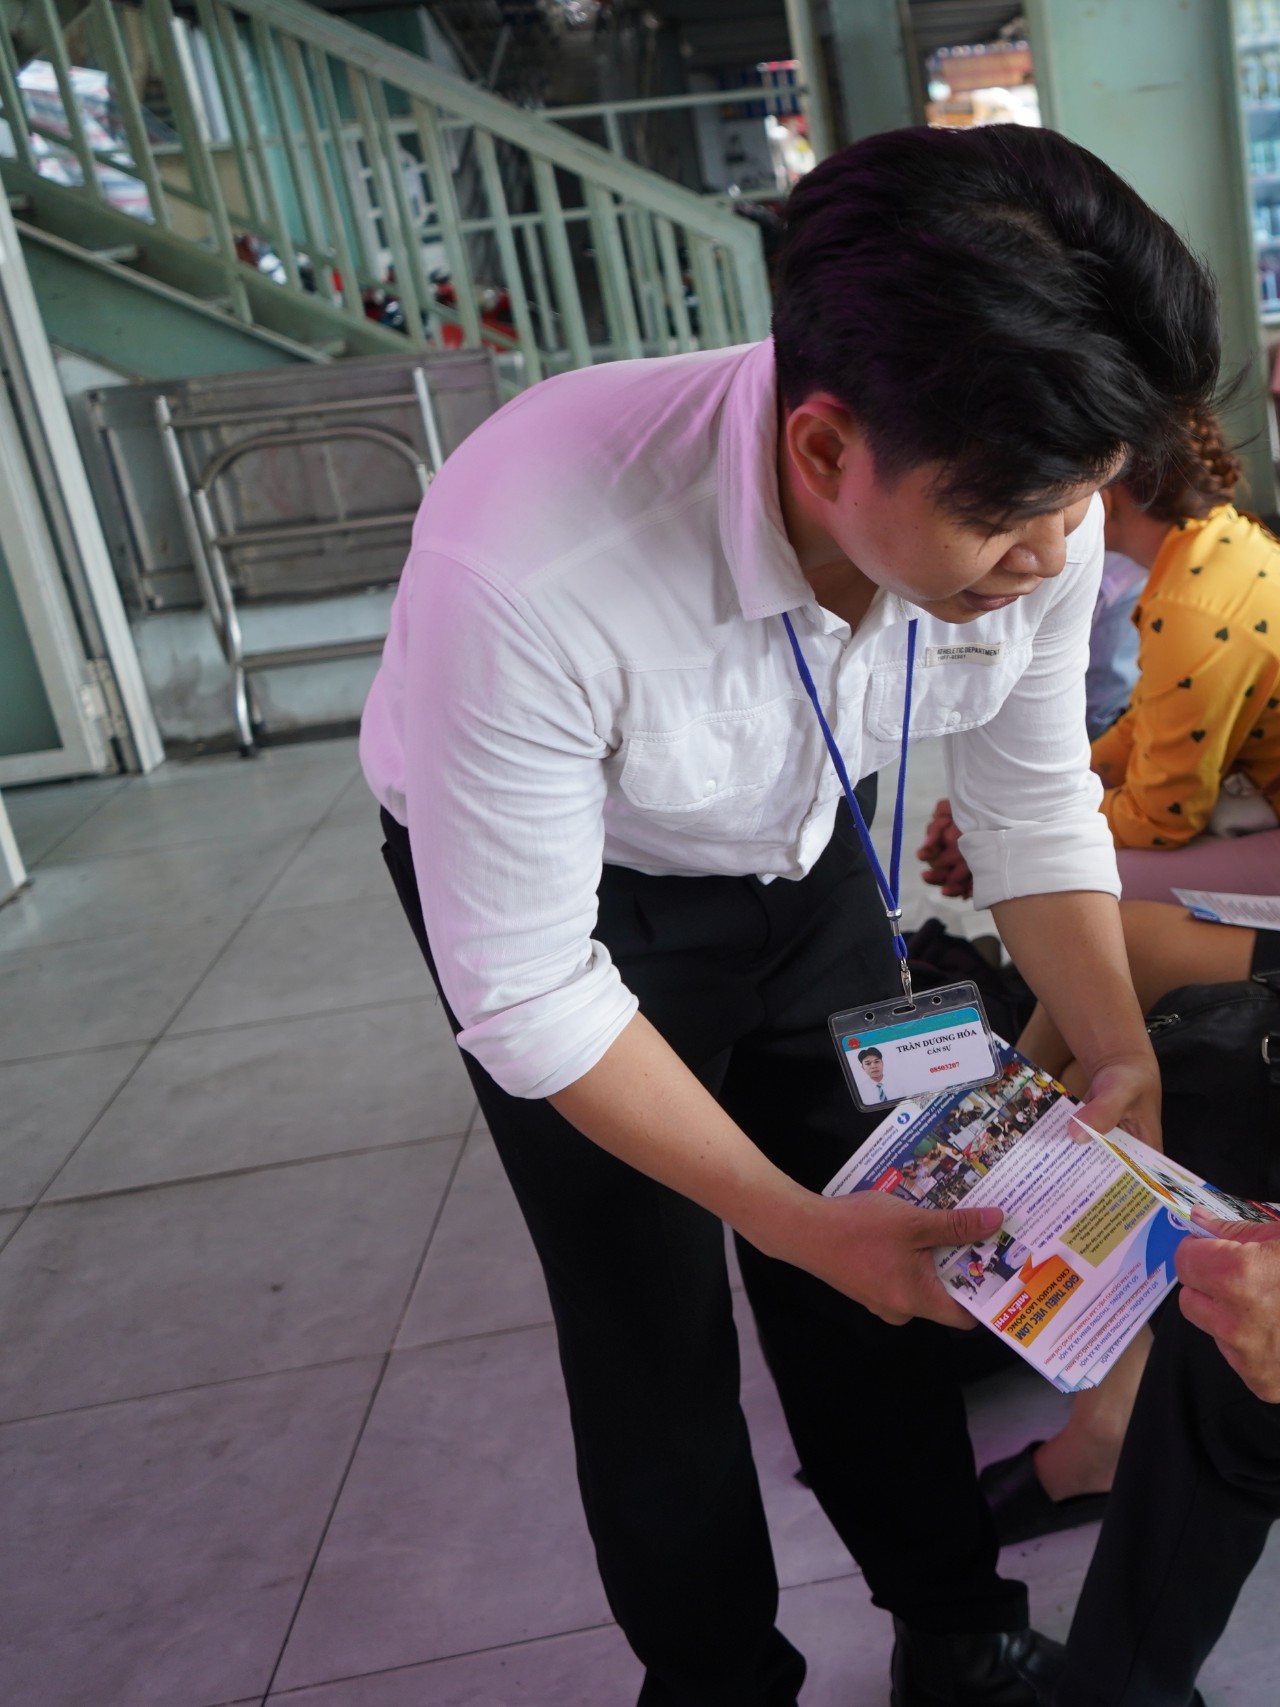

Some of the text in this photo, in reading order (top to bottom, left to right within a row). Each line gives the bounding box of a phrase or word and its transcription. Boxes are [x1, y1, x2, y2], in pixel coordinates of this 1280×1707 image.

[922, 1032, 956, 1047] DƯƠNG
[929, 1060, 960, 1074] 08503207
[1005, 1267, 1070, 1334] CHO NGƯỜI LAO ĐỘNG
[1014, 1273, 1081, 1342] GIỚI THIỆU VIỆC LÀM
[993, 1312, 1011, 1330] PHÍ
